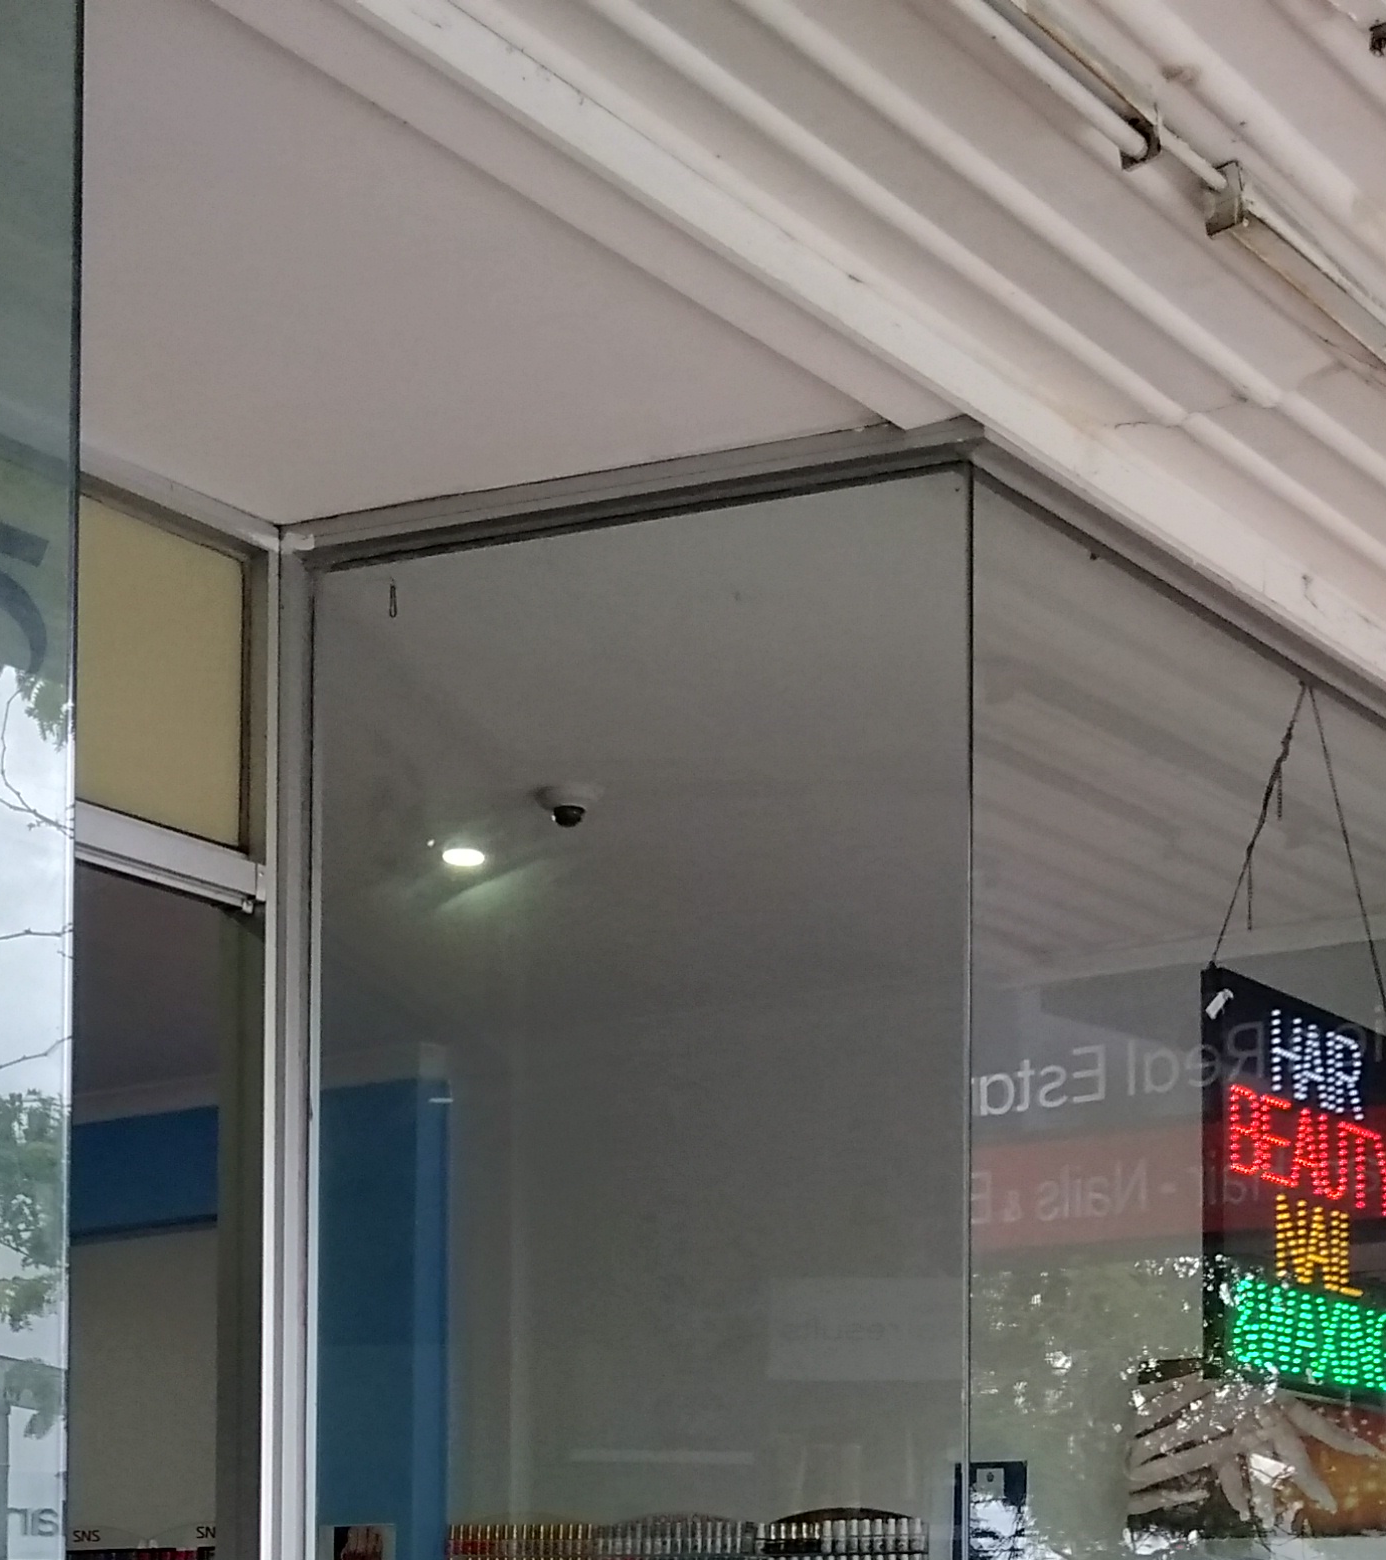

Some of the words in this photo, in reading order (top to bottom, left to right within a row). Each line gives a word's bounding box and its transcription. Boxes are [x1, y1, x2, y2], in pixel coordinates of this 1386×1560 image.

[1271, 1009, 1365, 1121] HAIR
[1275, 1194, 1364, 1297] NAIL
[72, 1529, 101, 1543] SNS
